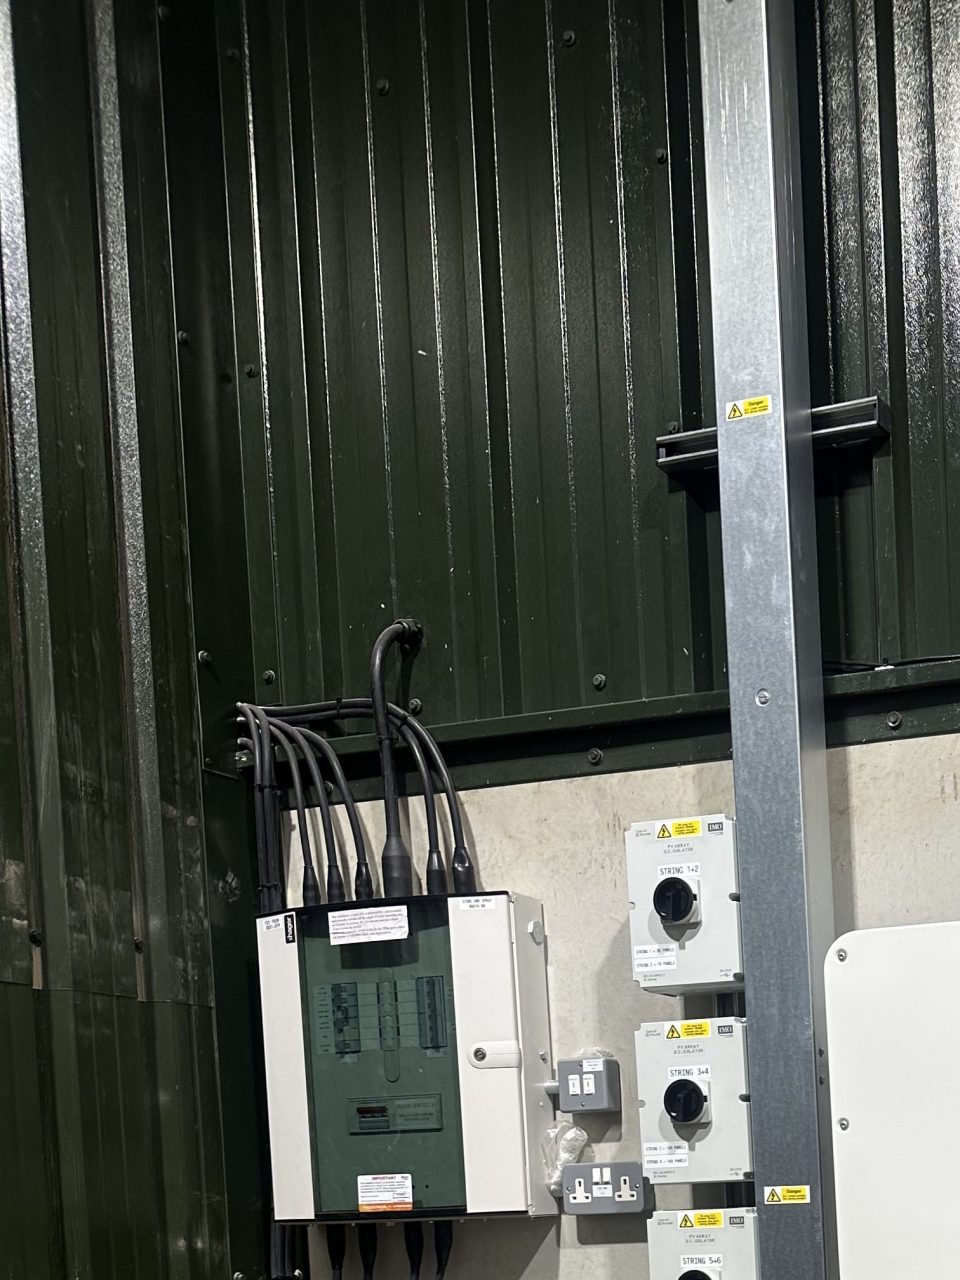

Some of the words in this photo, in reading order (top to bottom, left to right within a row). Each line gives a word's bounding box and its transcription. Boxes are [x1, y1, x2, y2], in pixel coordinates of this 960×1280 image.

[709, 822, 723, 832] IMO
[660, 867, 684, 875] STRING
[687, 865, 699, 873] 1+2
[718, 1025, 732, 1034] IMO
[670, 1069, 694, 1077] STRING
[697, 1068, 709, 1076] 3+4
[730, 1217, 744, 1225] IMO
[682, 1257, 706, 1265] STRING
